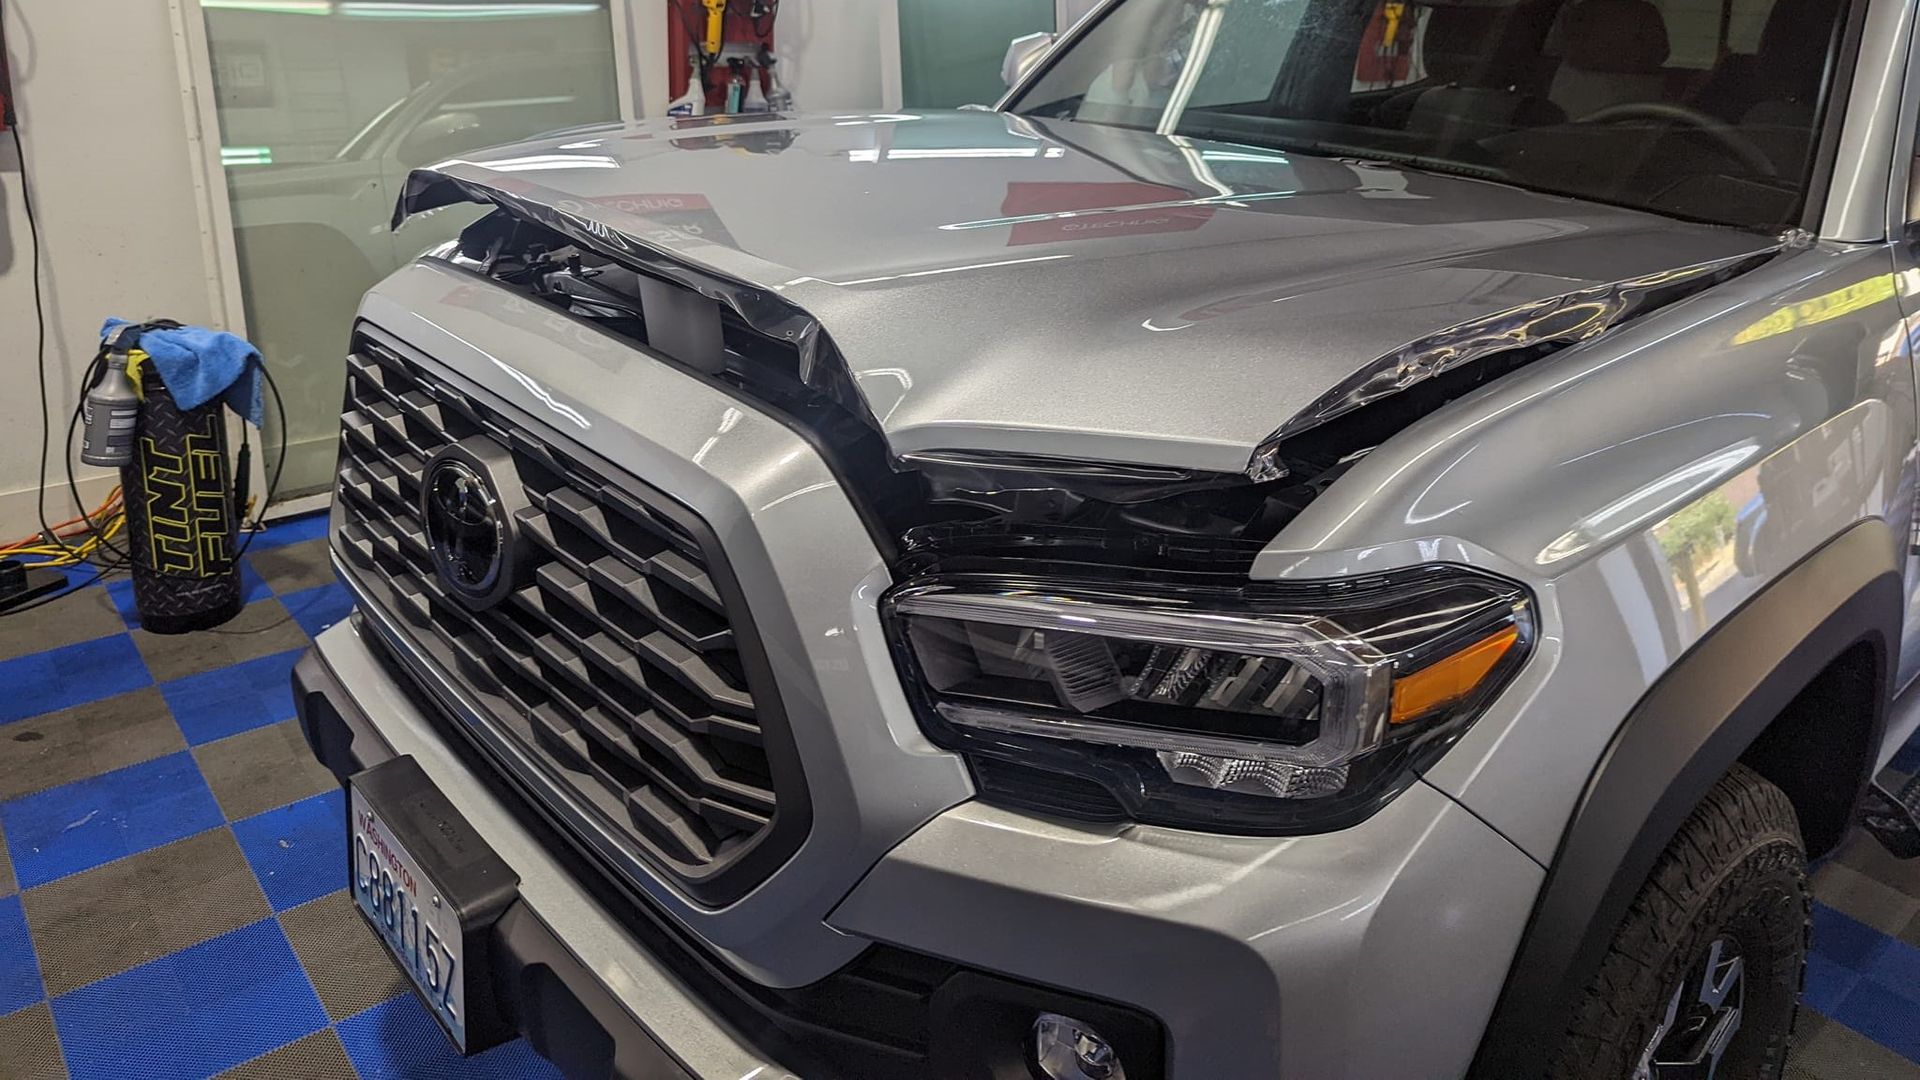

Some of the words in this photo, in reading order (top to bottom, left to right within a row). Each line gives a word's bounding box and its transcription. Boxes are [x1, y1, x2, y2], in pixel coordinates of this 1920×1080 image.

[139, 436, 194, 577] TINT
[186, 413, 233, 578] FUEL
[356, 832, 457, 1021] C88115Z
[358, 810, 417, 897] WASHINGTON
